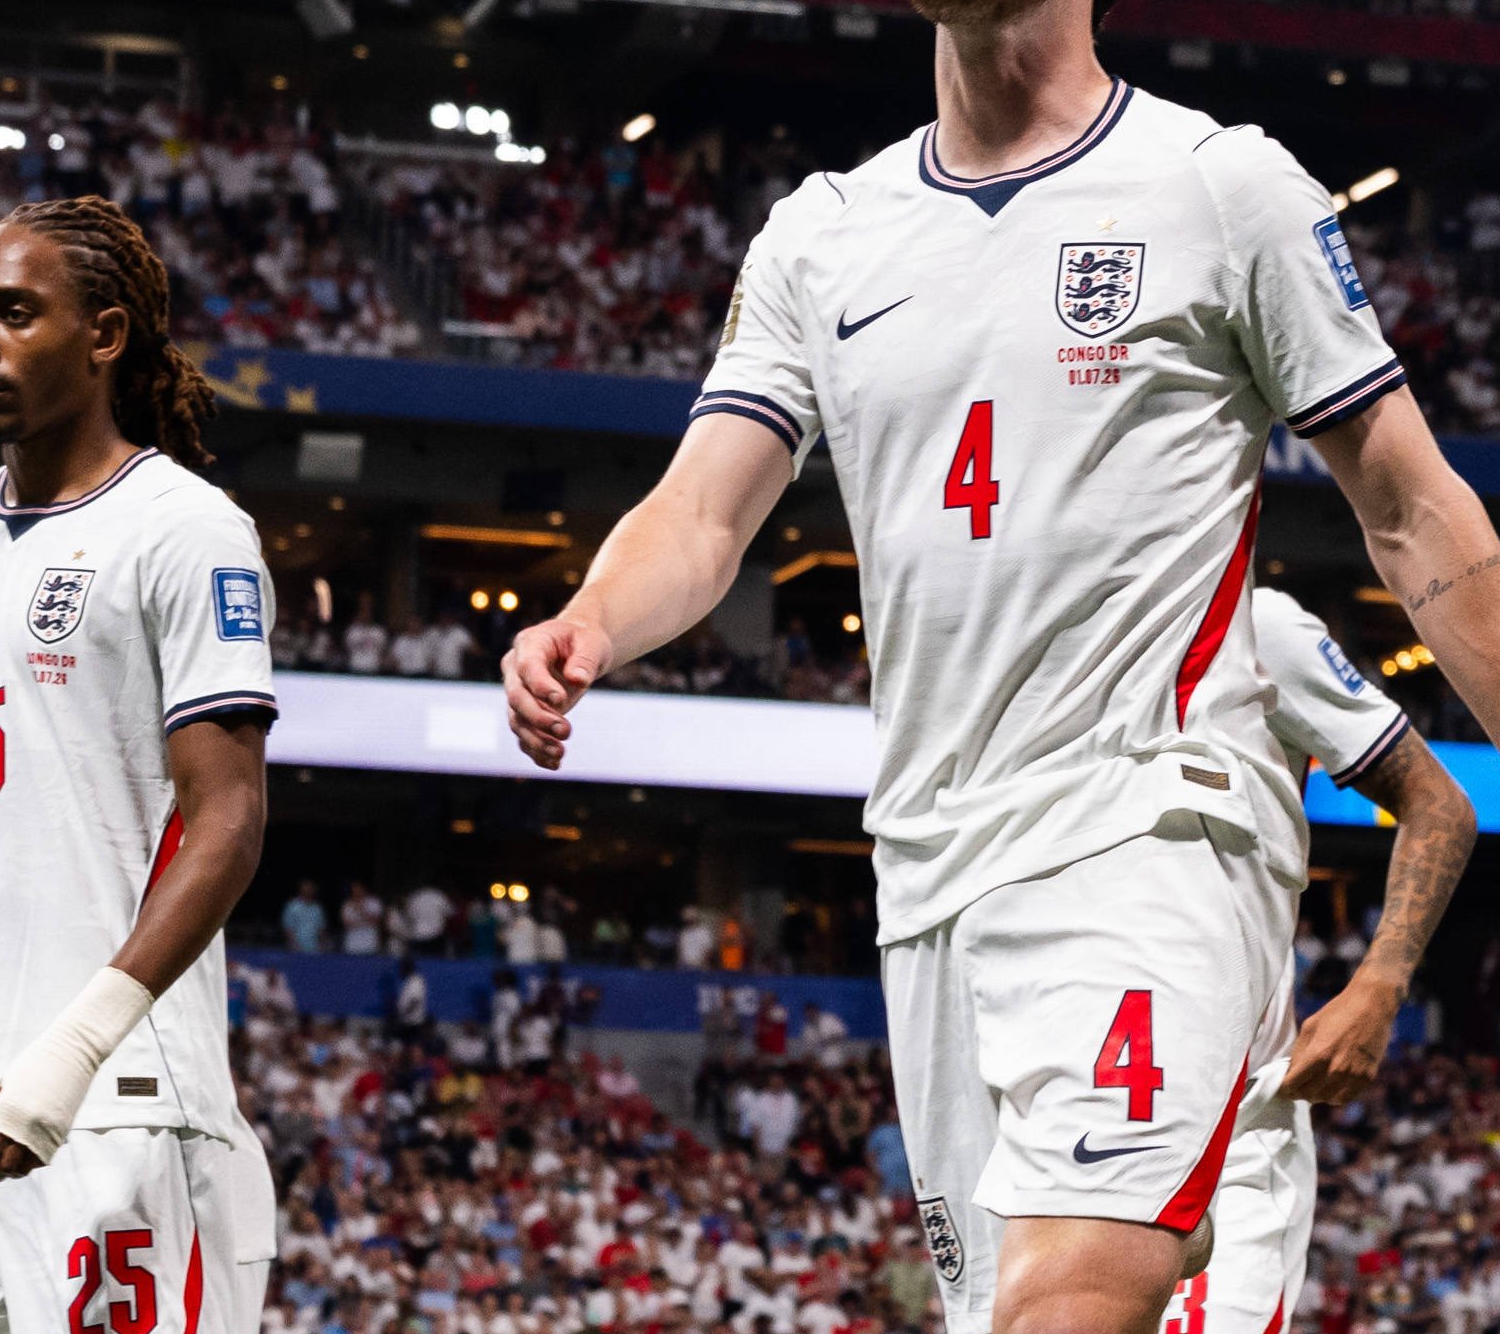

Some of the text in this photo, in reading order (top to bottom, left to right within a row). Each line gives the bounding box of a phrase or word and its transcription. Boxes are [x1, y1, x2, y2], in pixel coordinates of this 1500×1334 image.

[1057, 345, 1129, 363] CONGO DR
[943, 400, 1000, 539] 4
[61, 654, 77, 669] DR
[1092, 988, 1164, 1123] 4
